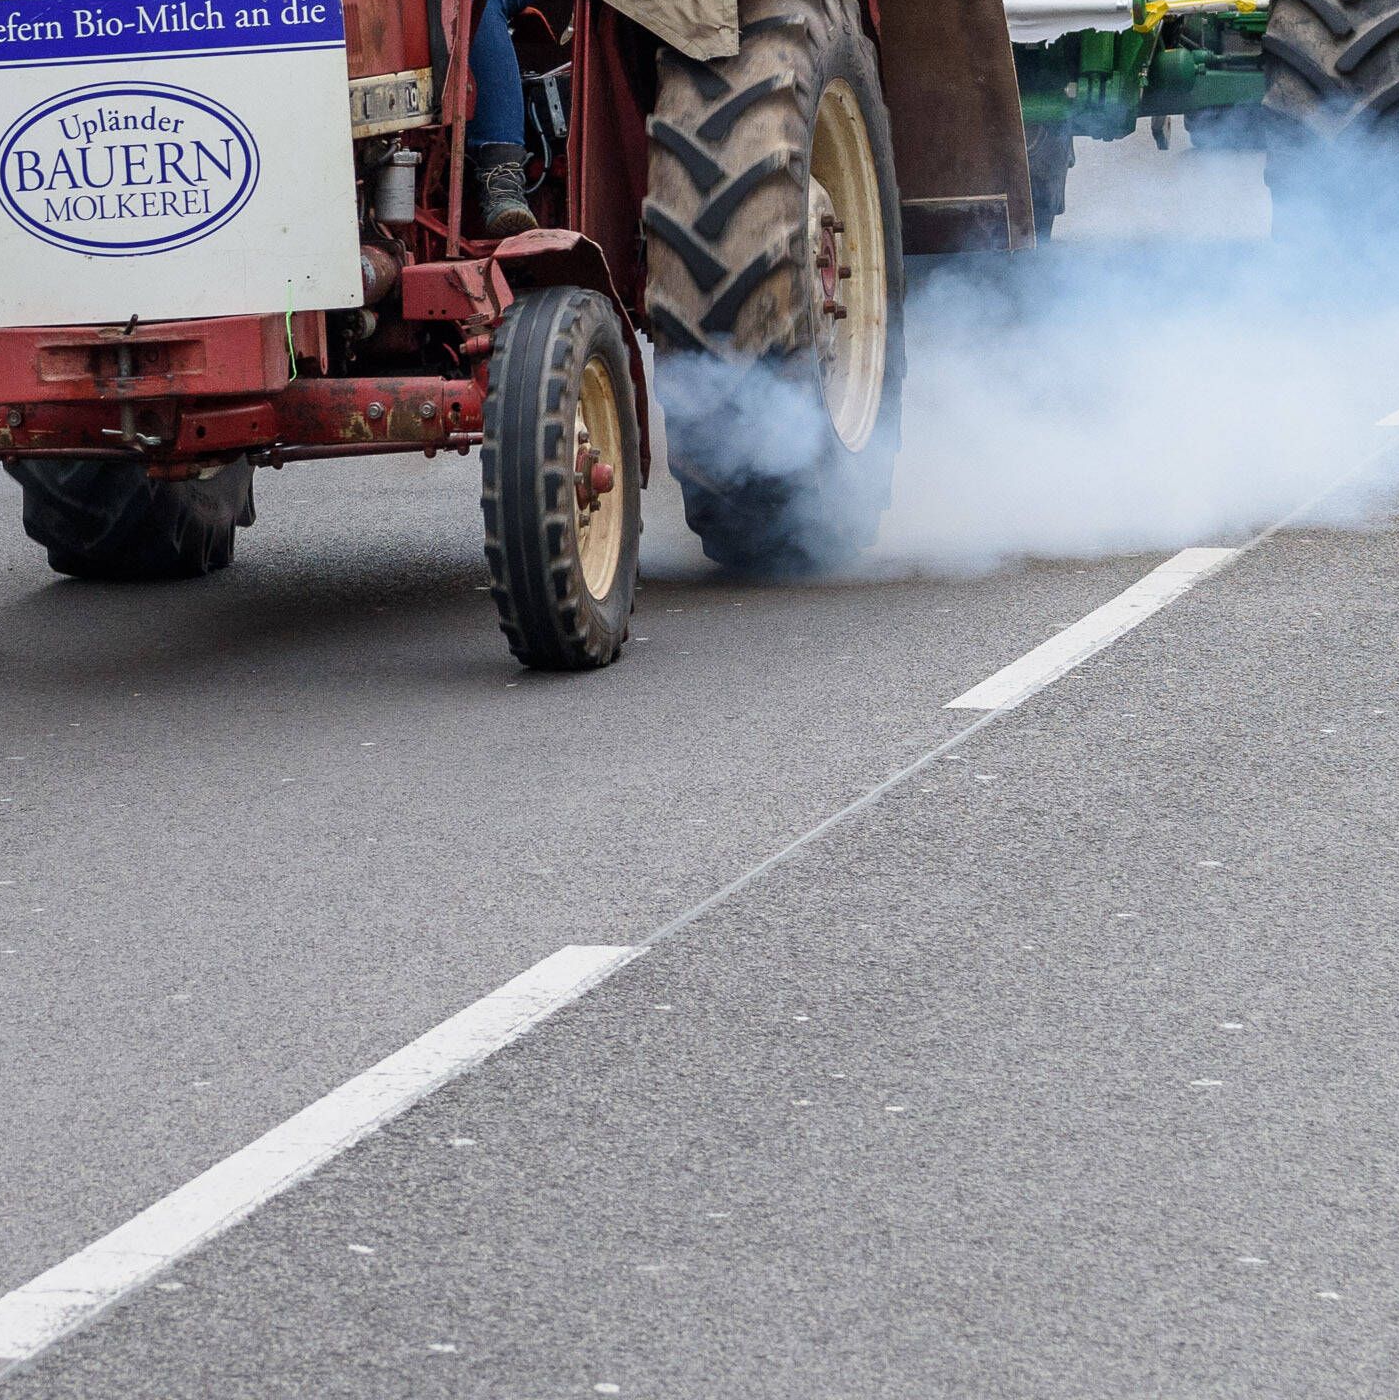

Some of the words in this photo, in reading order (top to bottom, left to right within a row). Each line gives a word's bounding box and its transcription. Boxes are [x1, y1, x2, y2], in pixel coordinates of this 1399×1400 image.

[74, 3, 225, 38] Bio-Milch
[235, 6, 271, 28] an
[58, 106, 185, 144] Upländer
[13, 138, 234, 192] BAUERN
[44, 188, 212, 223] MOLKEREI
